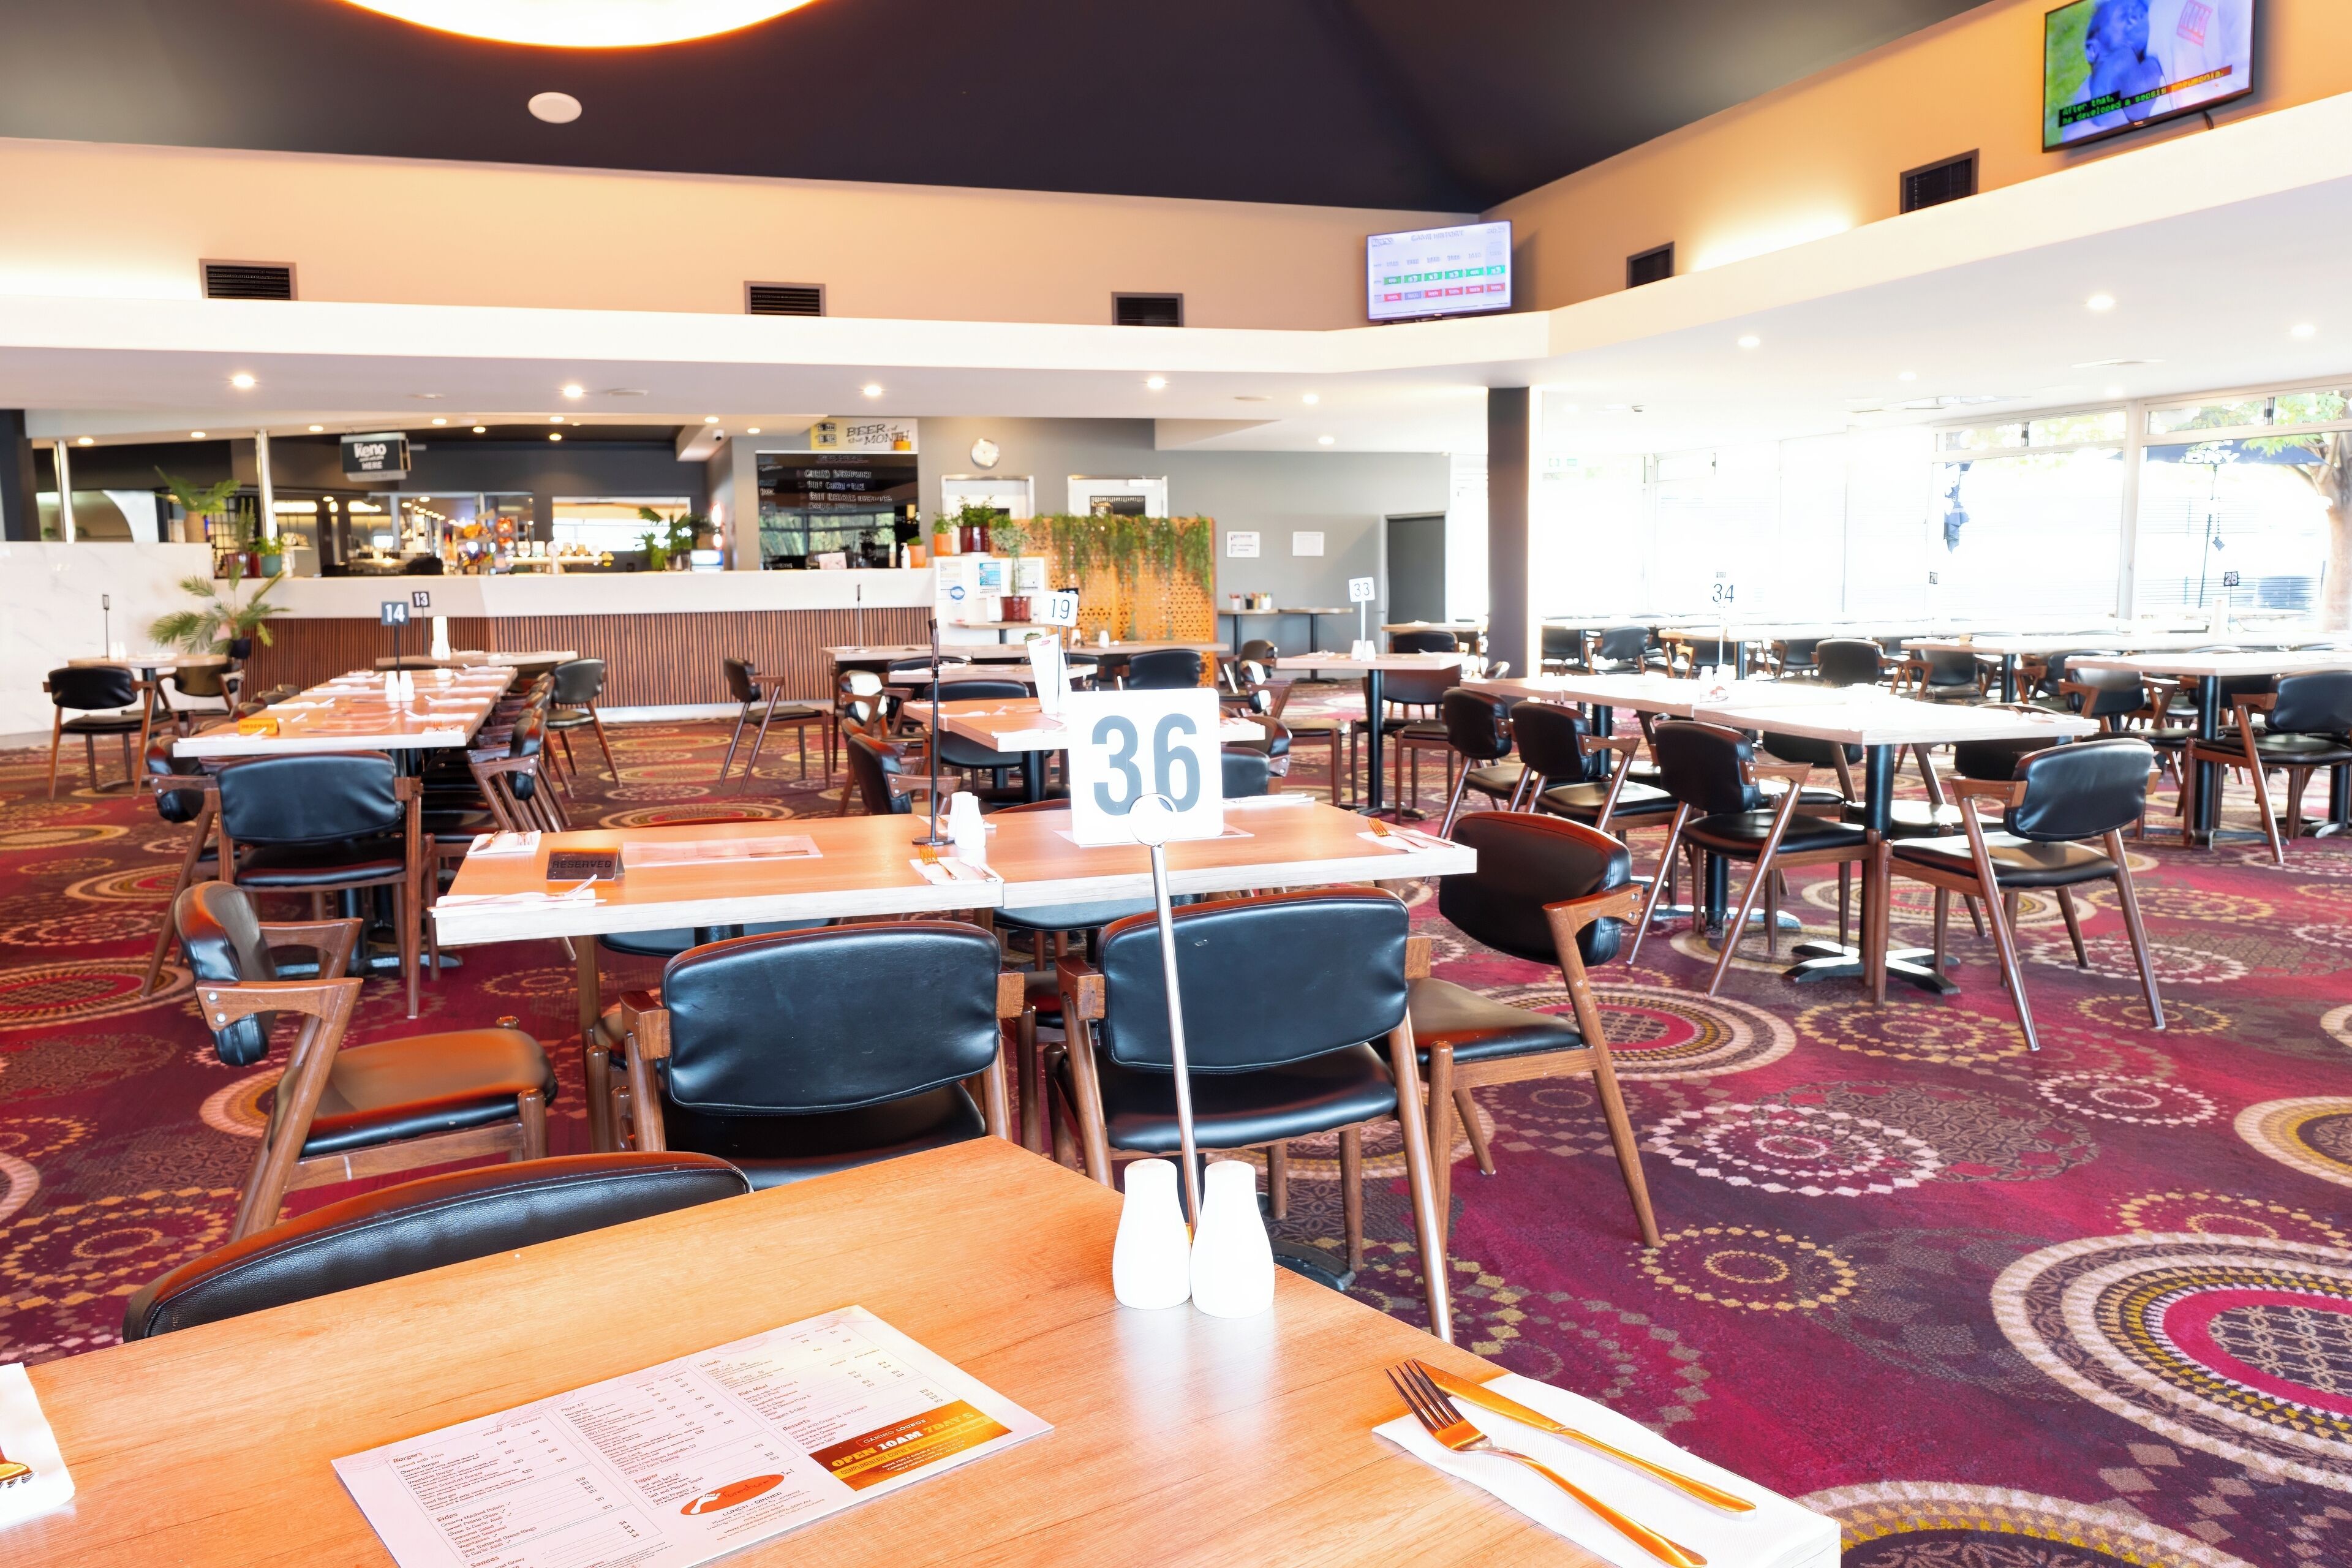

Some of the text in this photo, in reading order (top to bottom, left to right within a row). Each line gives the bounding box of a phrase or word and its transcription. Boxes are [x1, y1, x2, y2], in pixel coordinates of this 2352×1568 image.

[846, 424, 886, 437] BEER
[864, 430, 910, 445] MONTH
[361, 461, 383, 470] HERE
[1354, 582, 1370, 597] 33
[1713, 584, 1734, 603] 34
[414, 593, 428, 607] 13
[385, 603, 405, 622] 14
[1050, 598, 1070, 619] 19
[1091, 713, 1200, 816] 36
[552, 860, 612, 869] RESERVED
[831, 1447, 878, 1468] OPEN
[876, 1431, 925, 1450] 10AM
